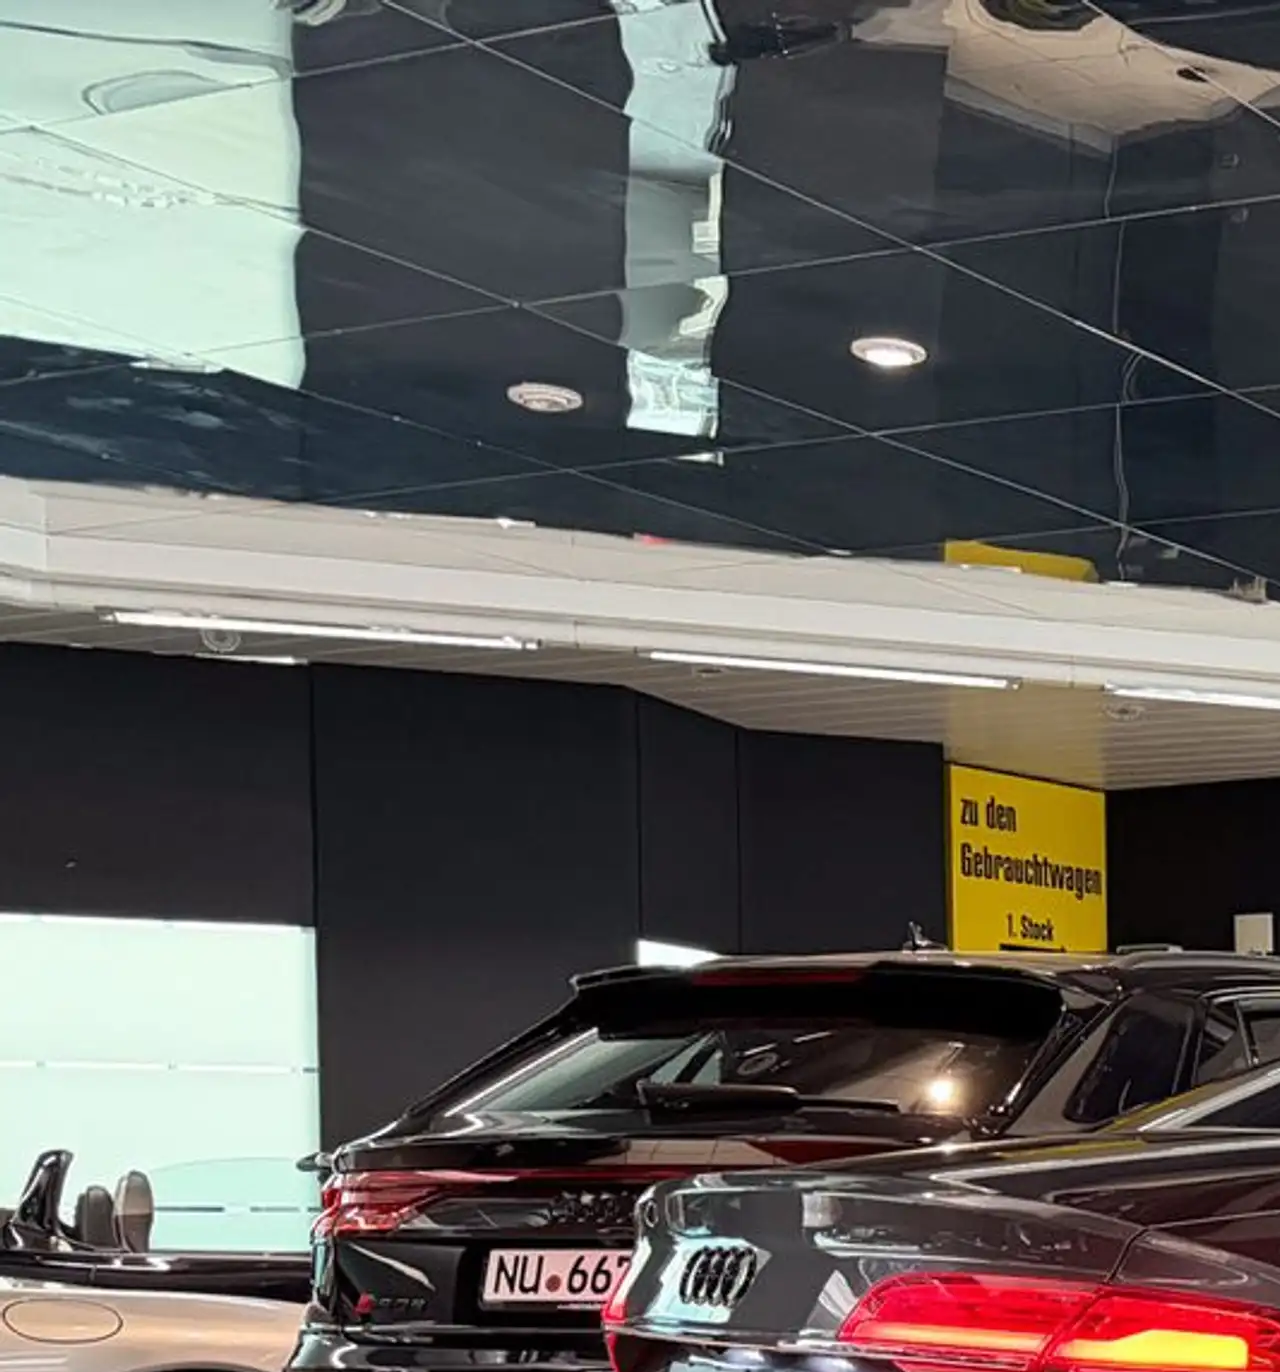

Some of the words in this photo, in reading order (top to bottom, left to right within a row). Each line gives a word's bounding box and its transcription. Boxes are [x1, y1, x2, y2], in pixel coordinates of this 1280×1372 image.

[960, 798, 978, 826] zu
[986, 796, 1016, 832] den
[960, 842, 1102, 901] Gebrauchtwagen
[1007, 912, 1017, 938] 1.
[1020, 914, 1054, 941] Stock
[493, 1255, 544, 1294] NU
